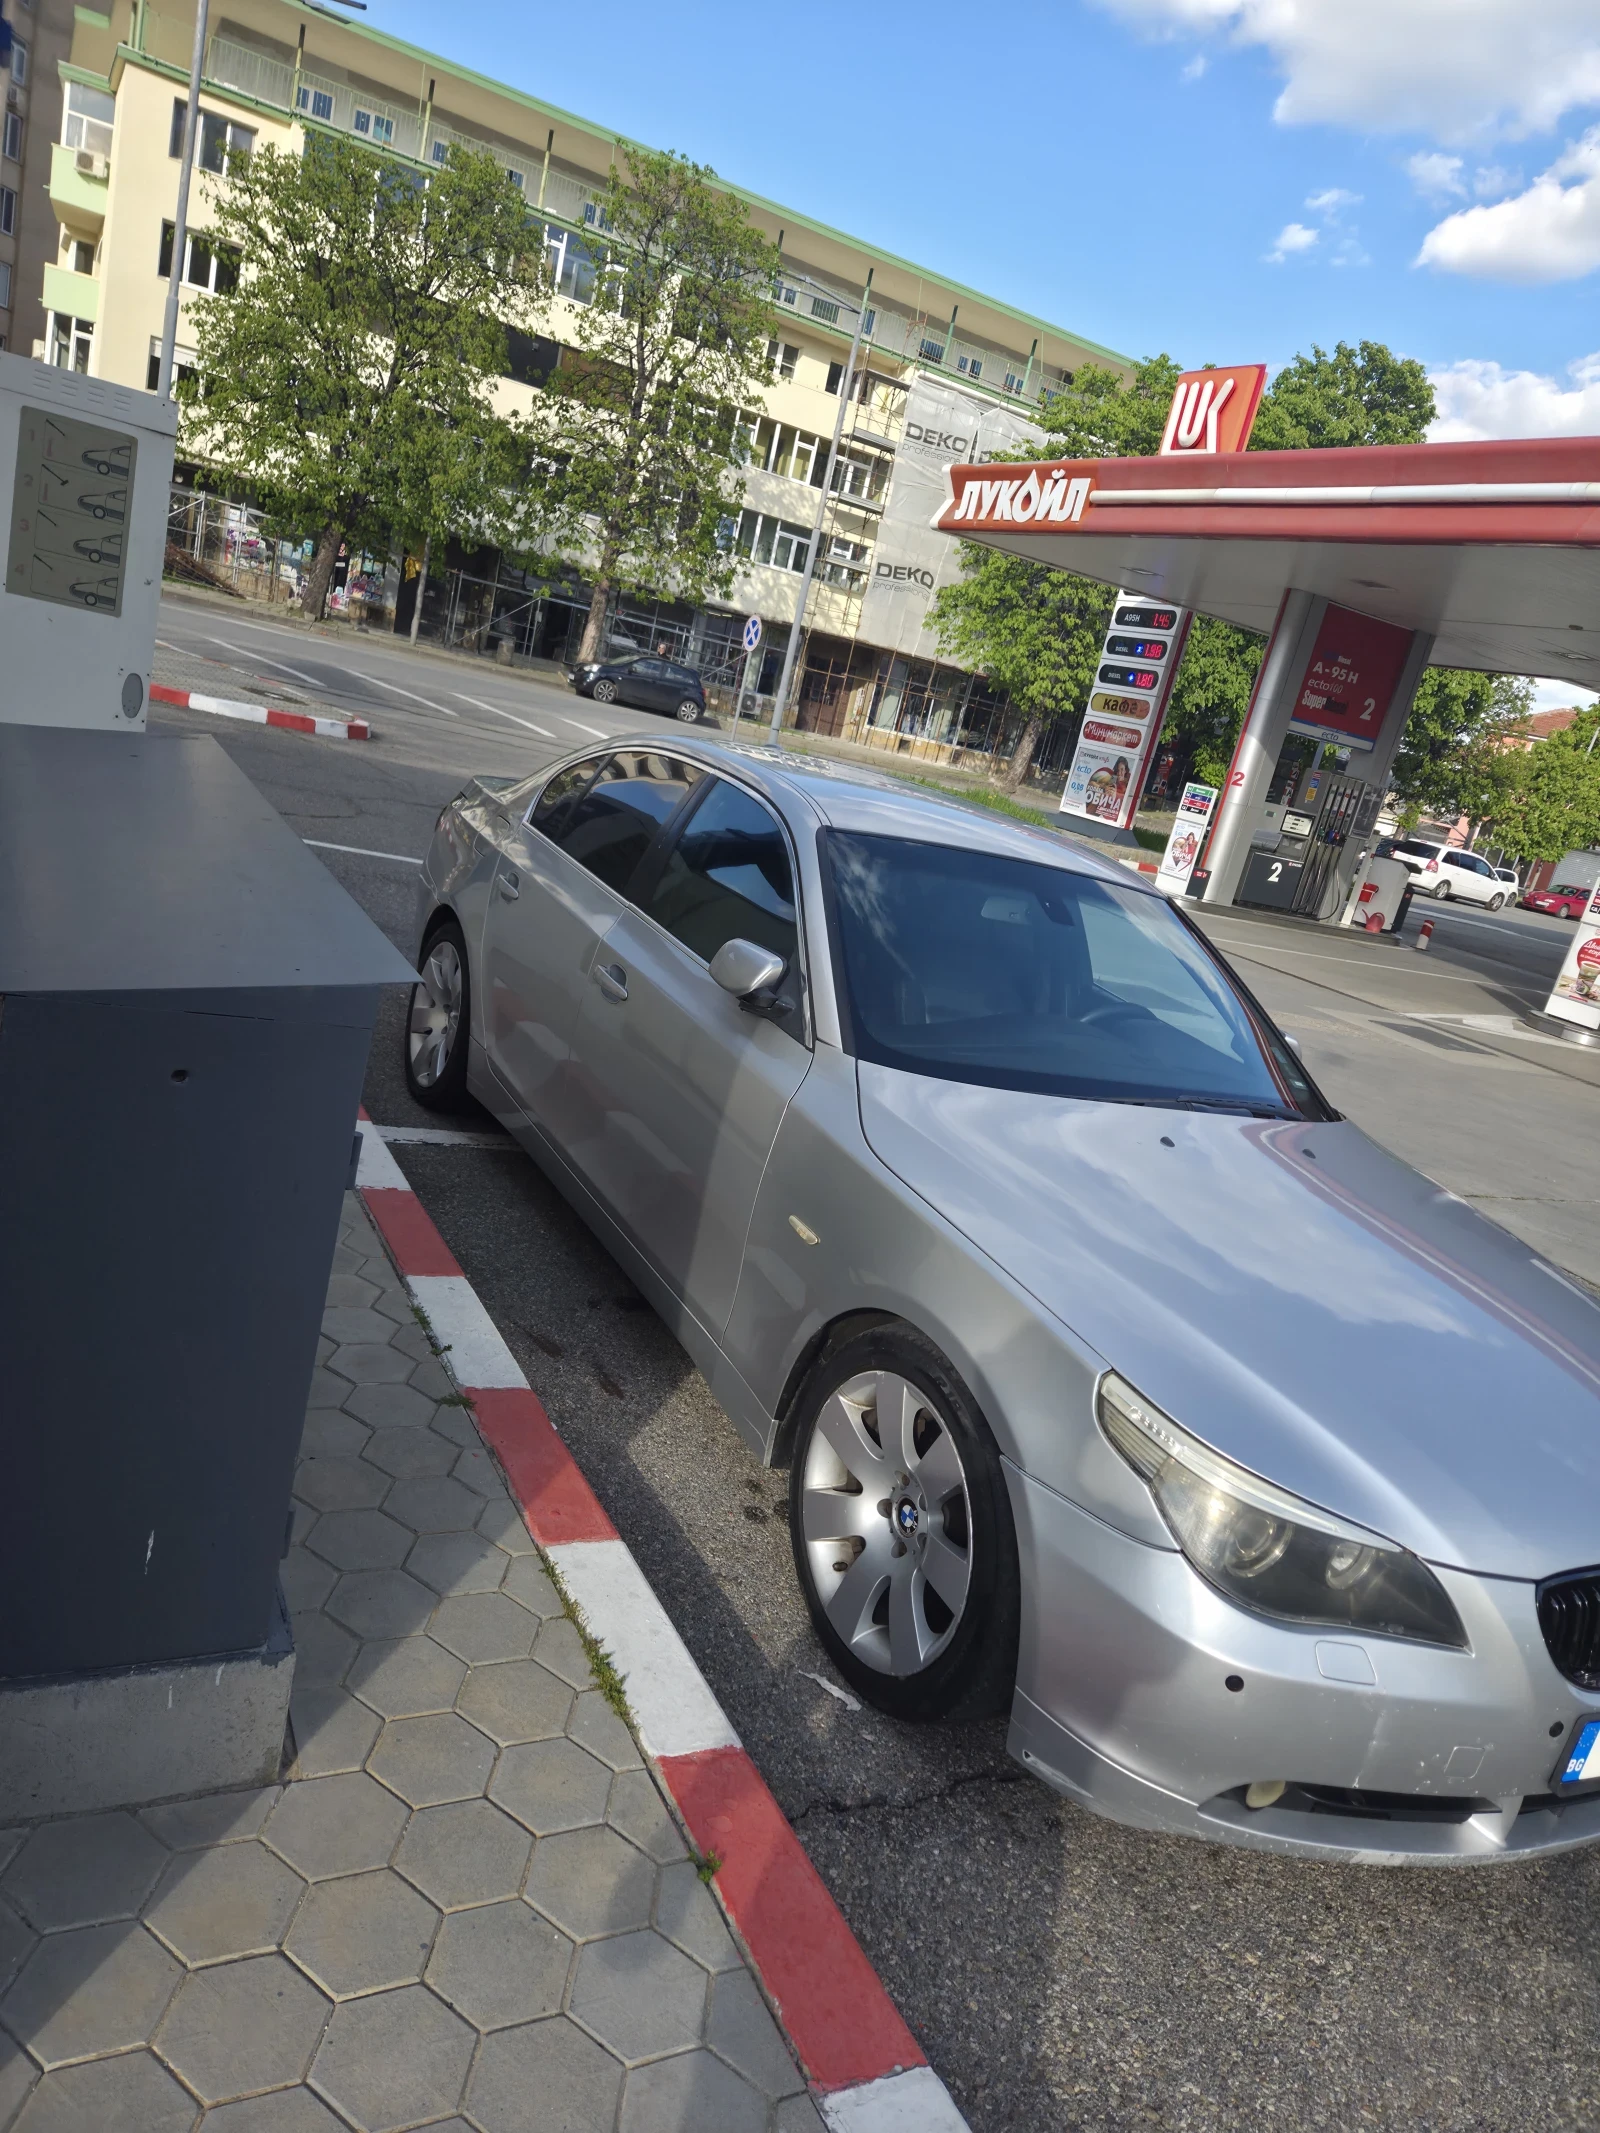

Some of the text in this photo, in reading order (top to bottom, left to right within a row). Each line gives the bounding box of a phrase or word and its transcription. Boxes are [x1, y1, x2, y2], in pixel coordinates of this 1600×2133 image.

[906, 422, 968, 453] DEKO
[953, 468, 1092, 523] ЛУКОЙЛ
[876, 562, 934, 589] DEKO
[1144, 643, 1163, 658] 1.98
[1135, 672, 1154, 687] 1.80
[1360, 698, 1376, 721] 2
[1321, 731, 1339, 741] ecto
[1231, 772, 1245, 787] 2
[1086, 791, 1121, 811] ОБИЧА
[1267, 862, 1282, 882] 2
[1566, 1758, 1585, 1773] BG
